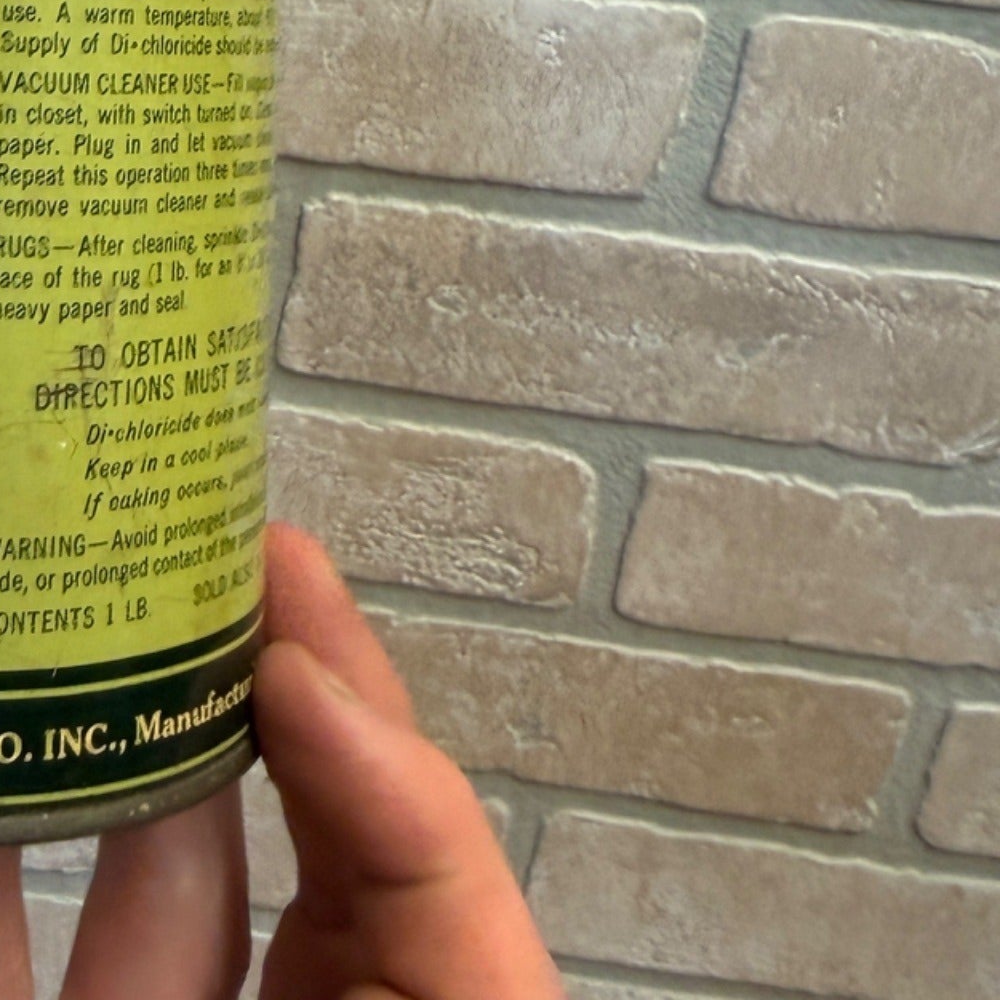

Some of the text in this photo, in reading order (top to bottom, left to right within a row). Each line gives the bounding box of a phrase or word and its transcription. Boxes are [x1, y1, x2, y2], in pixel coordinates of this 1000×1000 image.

[1, 3, 42, 24] use.
[54, 0, 72, 25] A
[84, 4, 135, 26] warm
[0, 30, 72, 59] Supply
[80, 32, 100, 54] of
[96, 72, 180, 96] CLEANER
[25, 102, 89, 128] closet,
[97, 103, 136, 126] with
[142, 103, 191, 125] switch
[72, 132, 116, 159] Plug
[125, 132, 141, 155] in
[150, 132, 180, 155] and
[187, 132, 206, 152] let
[72, 164, 109, 187] this
[114, 161, 191, 190] operation
[195, 160, 229, 182] three
[79, 199, 149, 217] vacuum
[155, 192, 208, 215] cleaner
[42, 264, 64, 289] of
[71, 264, 103, 288] the
[111, 267, 142, 291] rug
[170, 260, 190, 284] lb.
[194, 256, 214, 280] for
[57, 299, 113, 325] paper
[117, 292, 151, 317] and
[73, 343, 106, 371] TO
[120, 333, 198, 369] OBTAIN
[33, 372, 176, 412] DIRECTIONS
[183, 361, 229, 397] MUST
[84, 457, 135, 481] Keep
[140, 455, 157, 474] in
[164, 453, 176, 469] a
[179, 439, 213, 466] cool
[83, 491, 104, 521] If
[163, 508, 227, 545] prolonged
[35, 571, 56, 592] or
[62, 556, 150, 594] prolonged
[152, 545, 204, 575] contact
[106, 602, 115, 626] 1
[43, 721, 128, 756] INC.,
